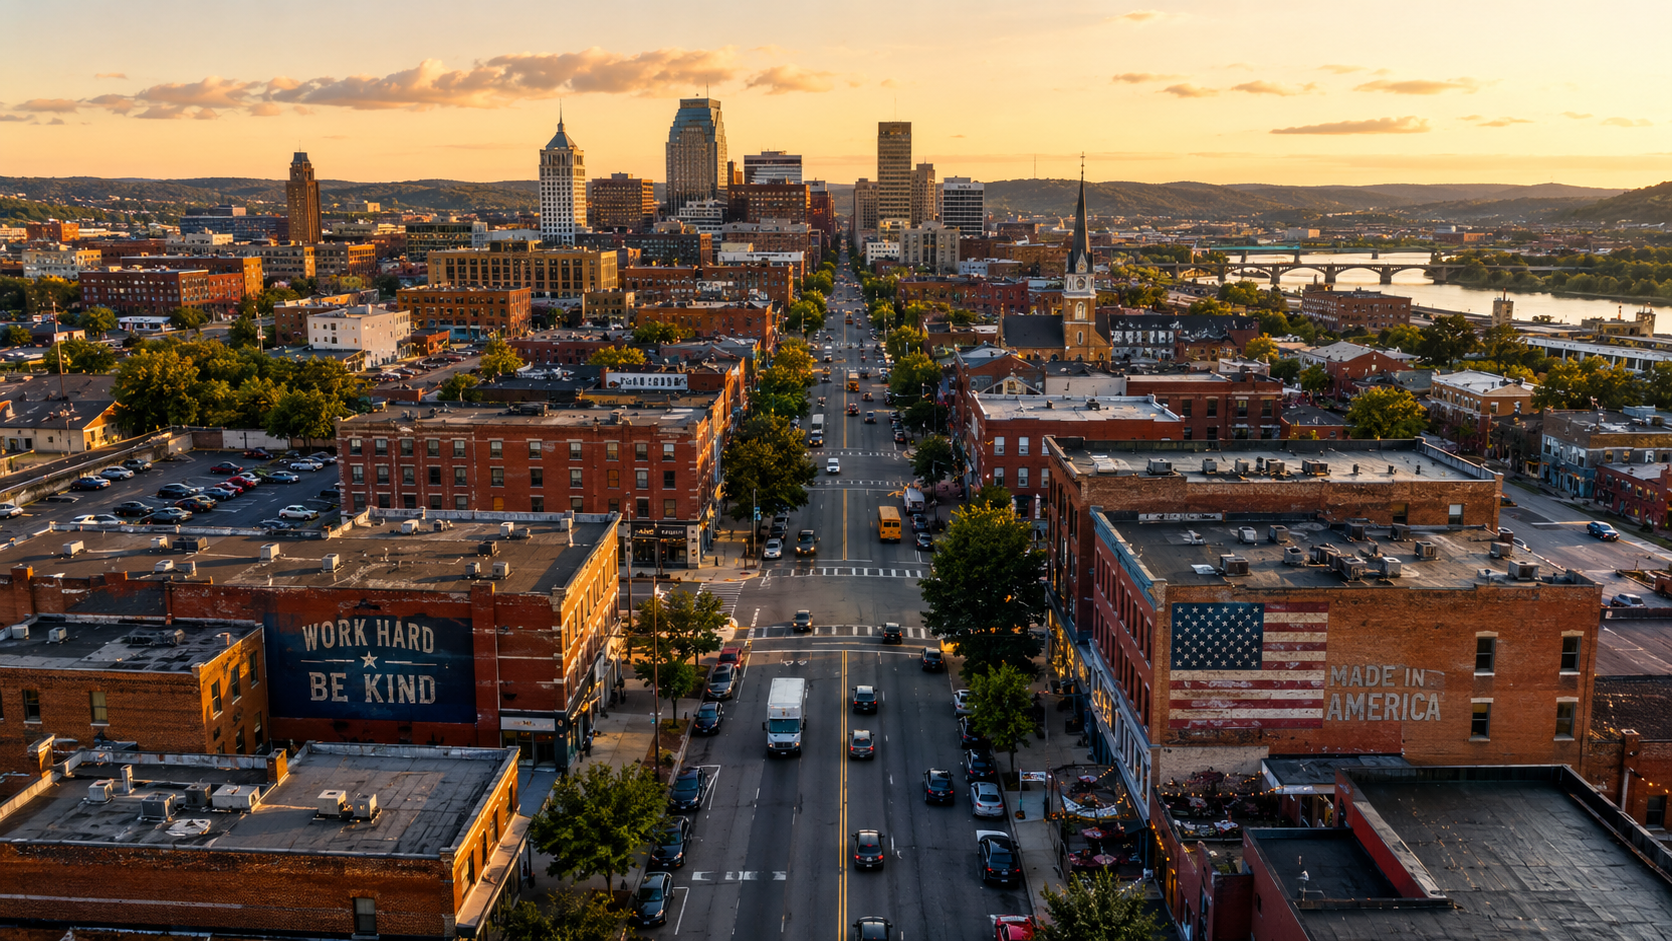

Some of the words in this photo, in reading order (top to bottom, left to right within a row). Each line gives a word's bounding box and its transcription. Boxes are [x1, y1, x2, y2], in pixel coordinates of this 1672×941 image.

[302, 618, 368, 651] WORK
[376, 619, 435, 654] HARD
[308, 672, 348, 703] BE
[364, 673, 436, 705] KIND
[1329, 665, 1396, 687] MADE
[1405, 667, 1426, 687] IN
[1326, 692, 1441, 721] AMERICA
